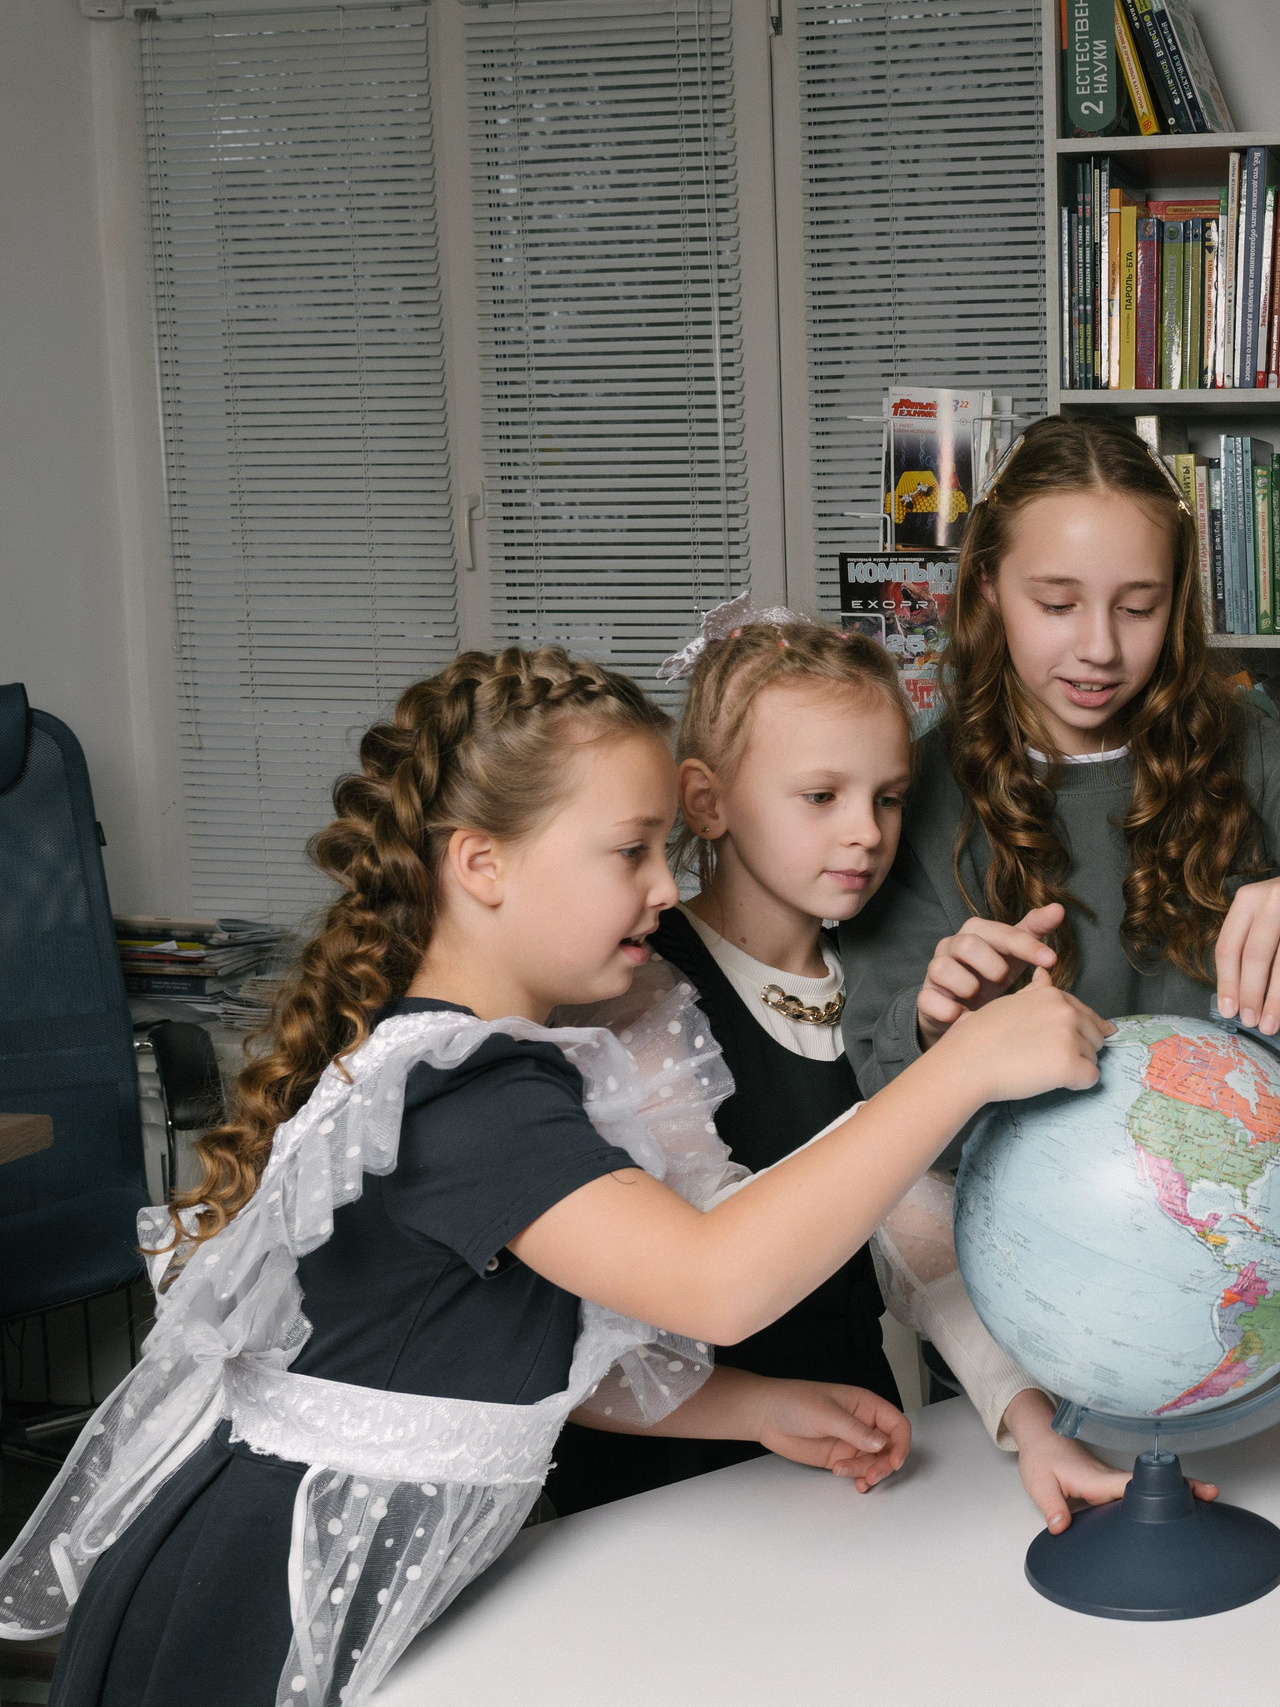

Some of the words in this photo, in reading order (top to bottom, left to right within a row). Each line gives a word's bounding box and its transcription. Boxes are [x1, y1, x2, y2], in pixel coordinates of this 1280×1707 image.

[1092, 39, 1108, 94] НАУКИ
[1080, 100, 1104, 115] 2
[1250, 180, 1259, 208] должны
[1248, 229, 1258, 278] образованные
[1248, 279, 1256, 312] мальчики
[959, 400, 970, 409] 22
[1197, 482, 1205, 510] ЖИЗНИ
[1198, 511, 1206, 541] НАШЕЙ
[1198, 541, 1208, 573] РИТМЫ
[885, 634, 926, 653] 25
